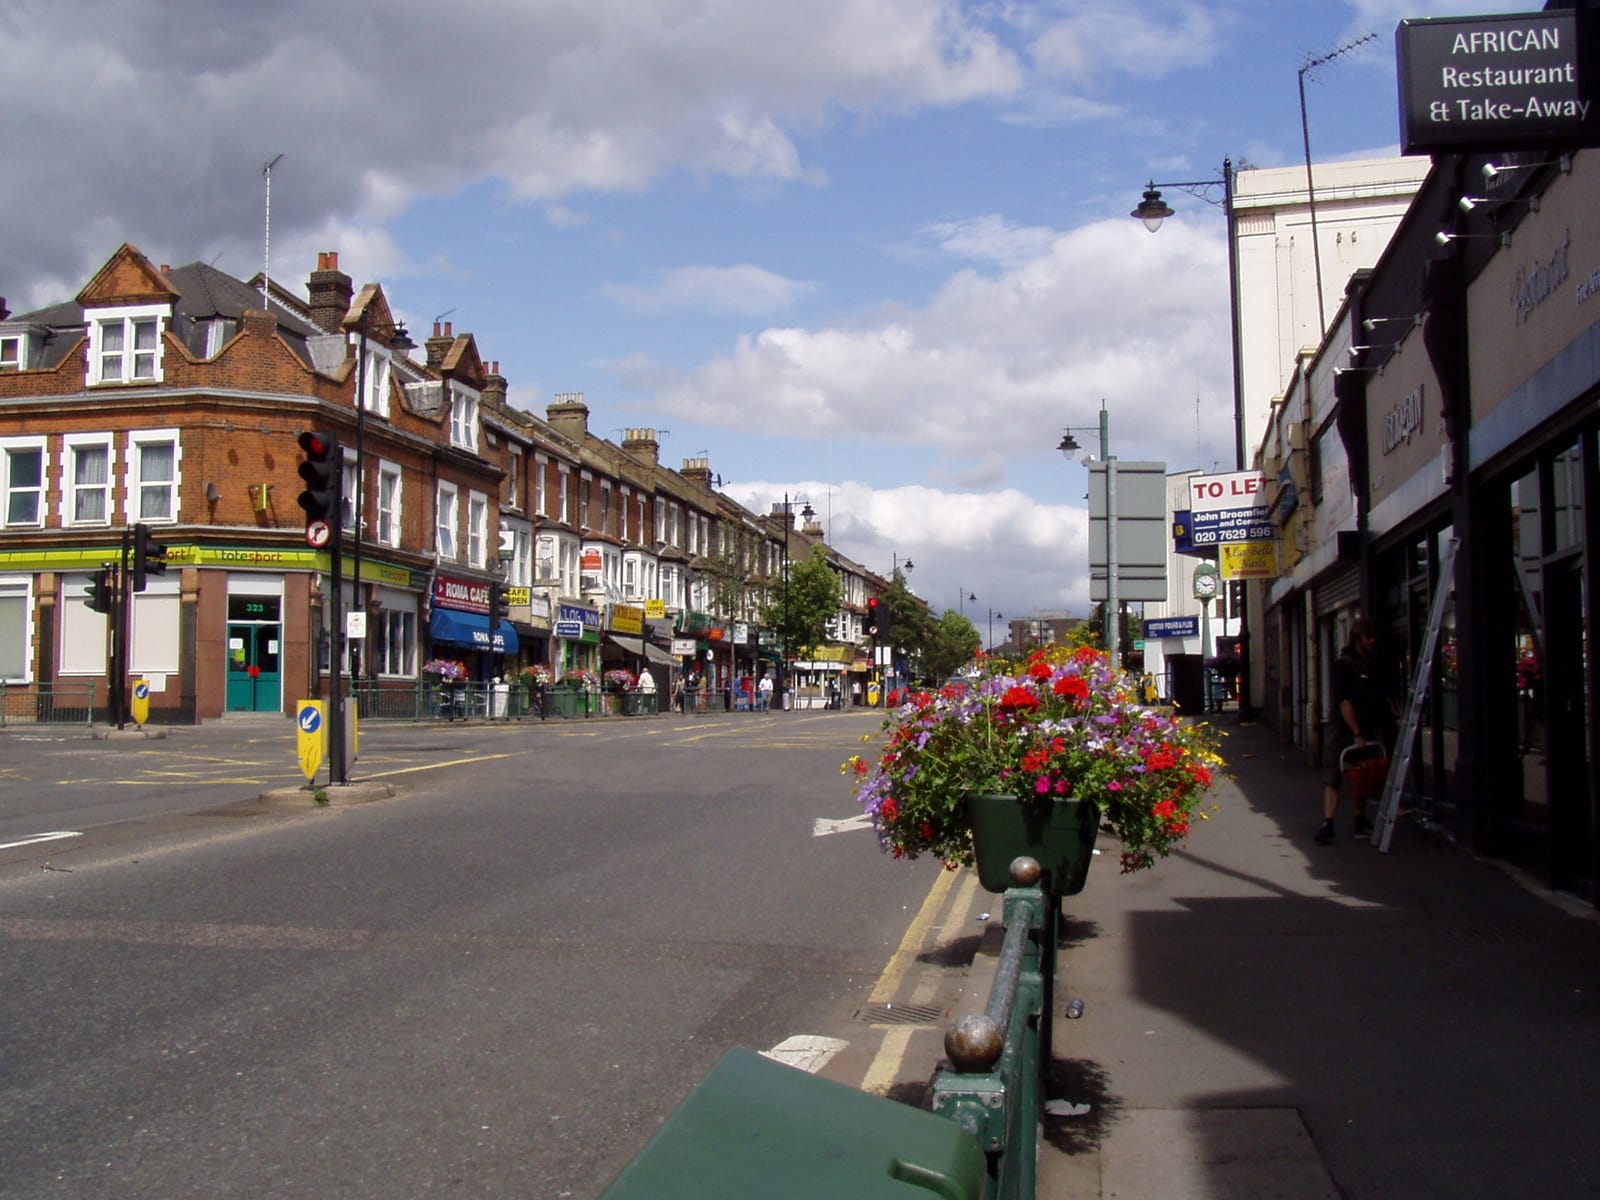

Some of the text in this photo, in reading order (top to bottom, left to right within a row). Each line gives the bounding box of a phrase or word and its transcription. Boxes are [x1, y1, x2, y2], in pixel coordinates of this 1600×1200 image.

[1451, 28, 1560, 54] AFRICAN
[1442, 63, 1575, 88] Restaurant
[1429, 97, 1591, 122] & Take-Away
[1193, 482, 1224, 499] TO
[1194, 508, 1268, 522] John Broomfiel
[1219, 519, 1235, 528] and
[1195, 532, 1216, 543] 020
[1218, 529, 1247, 540] 7629
[221, 551, 283, 564] totesport
[445, 583, 469, 601] ROMA
[245, 604, 264, 613] 323
